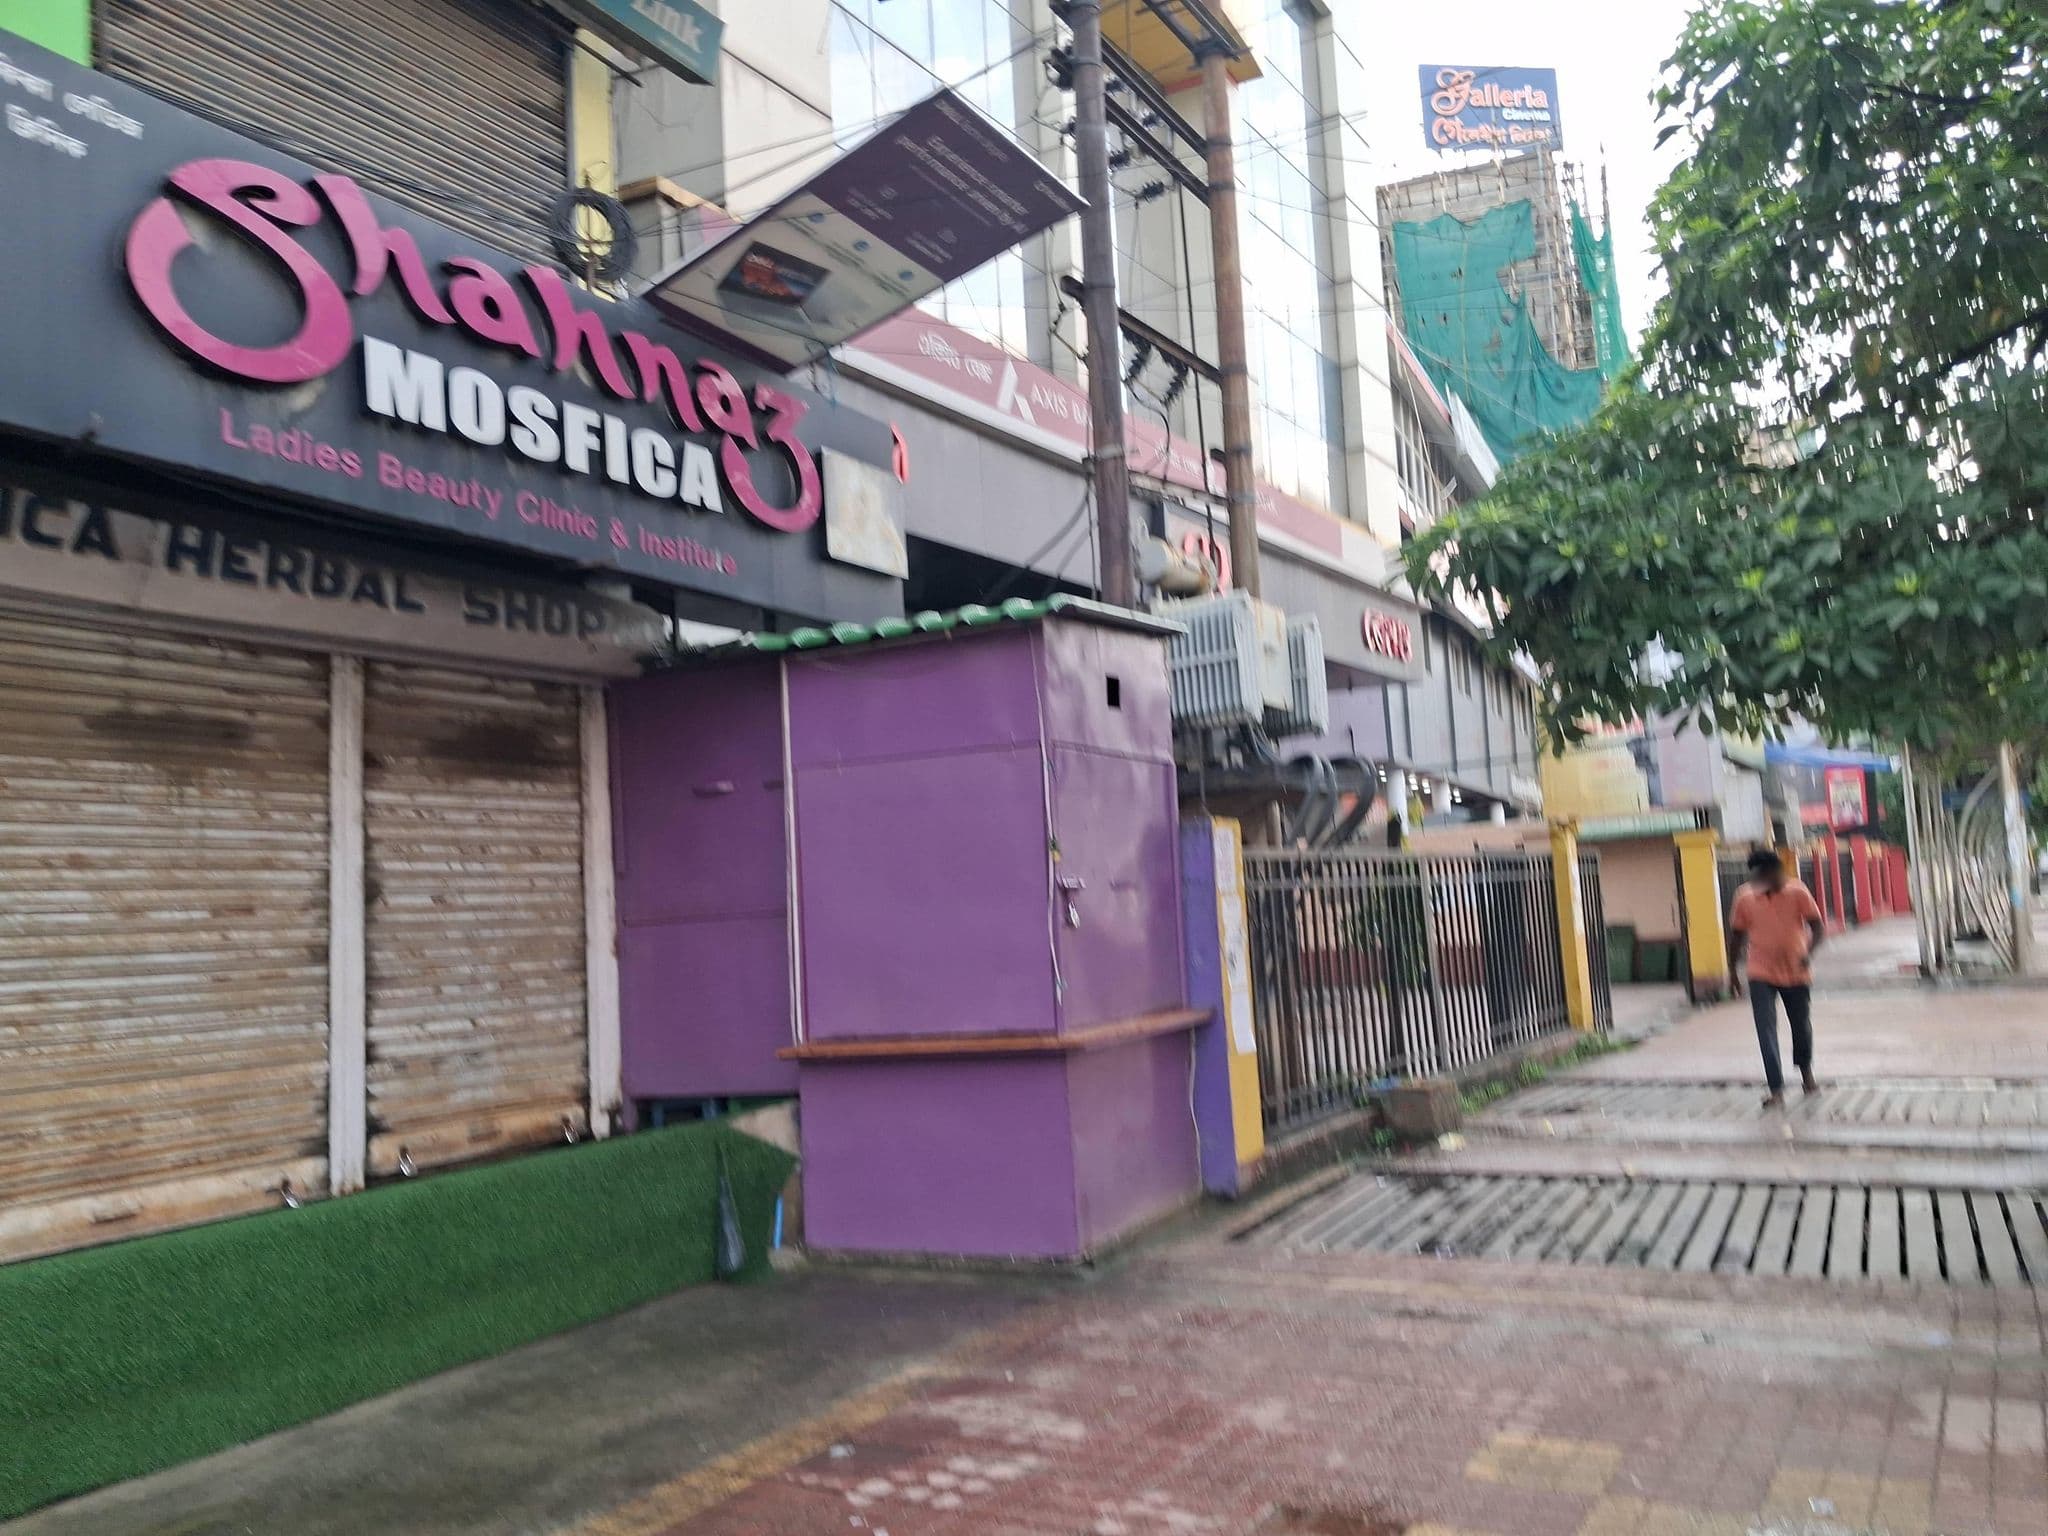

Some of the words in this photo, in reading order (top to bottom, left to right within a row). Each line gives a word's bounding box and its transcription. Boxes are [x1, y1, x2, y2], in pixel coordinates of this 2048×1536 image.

[1431, 67, 1549, 116] Galleria
[126, 158, 821, 534] Shahnaz
[1031, 384, 1069, 418] AXIS
[220, 406, 363, 480] Ladies
[377, 449, 502, 521] Beauty
[515, 489, 599, 541] Clinic
[608, 518, 631, 551] &
[636, 523, 738, 576] Institute
[363, 335, 724, 514] MOSFICA
[166, 522, 427, 614] HERBAL
[462, 585, 607, 642] SHOP
